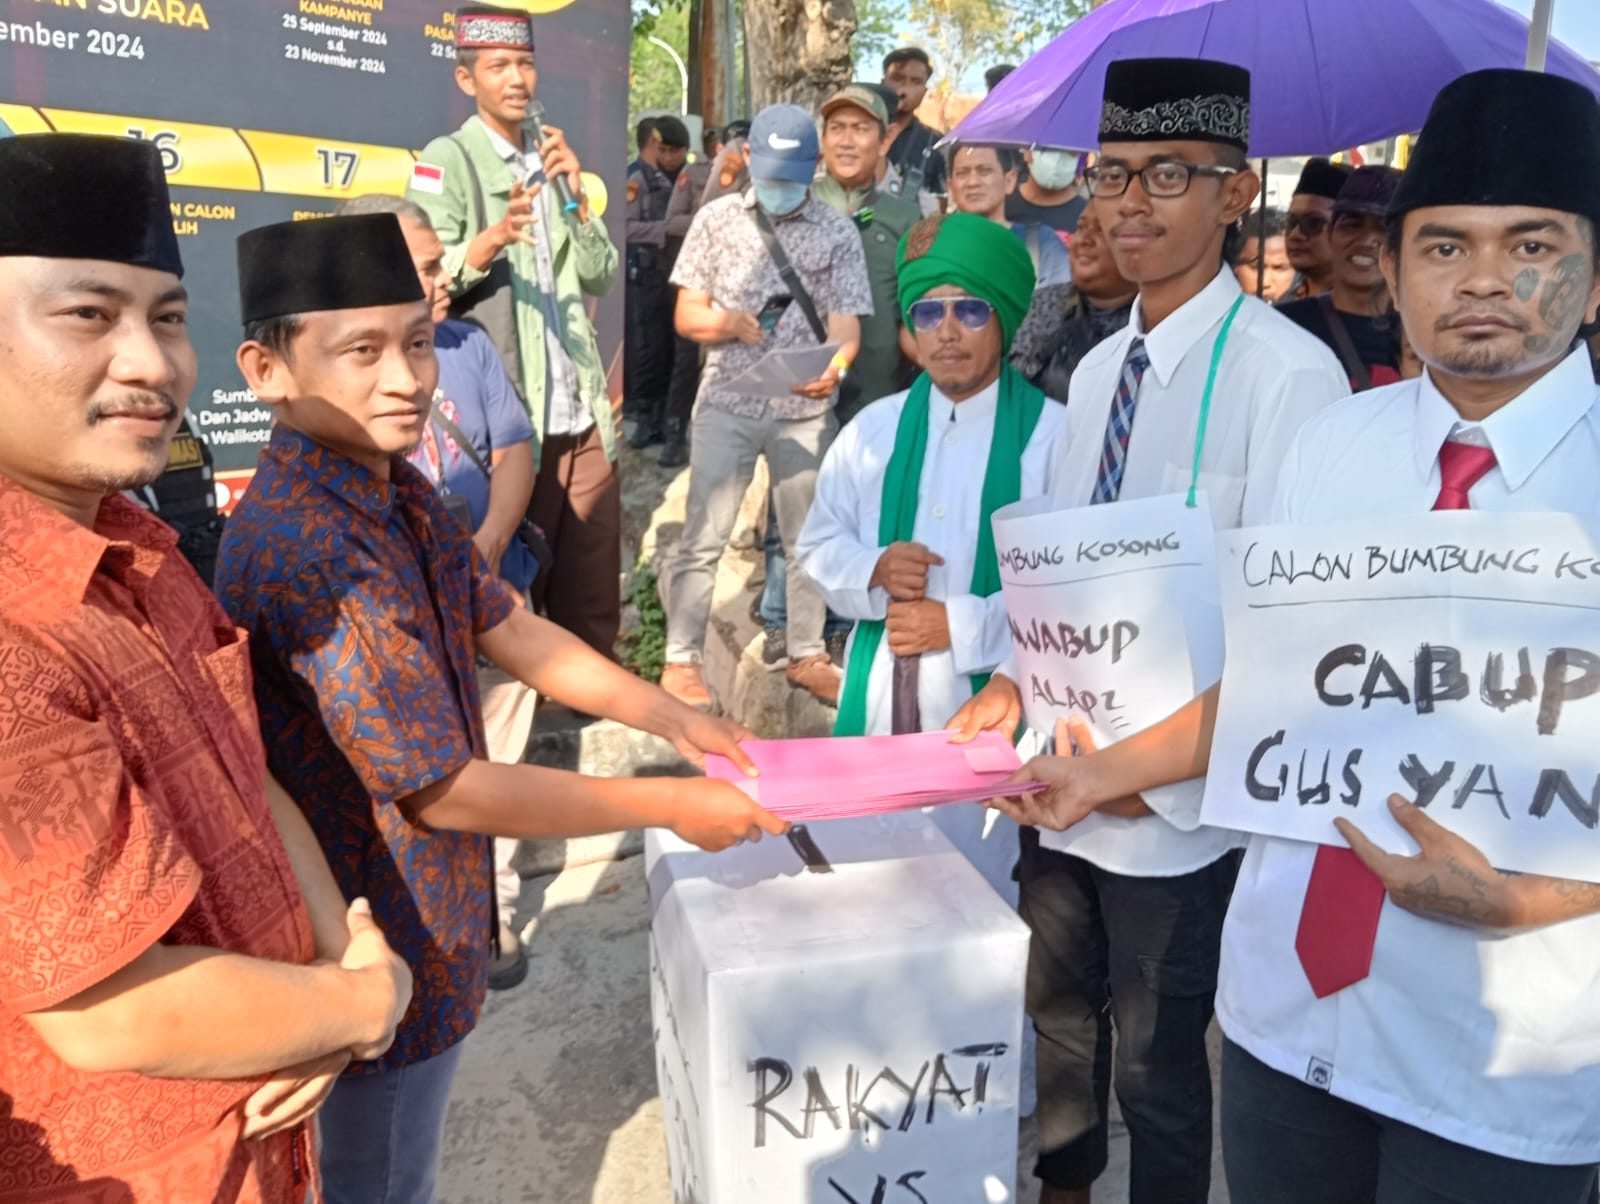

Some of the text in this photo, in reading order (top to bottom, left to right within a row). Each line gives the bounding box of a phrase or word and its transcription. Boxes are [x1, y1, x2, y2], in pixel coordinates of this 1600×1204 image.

[97, 0, 210, 30] SUARA
[299, 1, 372, 26] KAMPANYE
[86, 29, 145, 60] 2024
[282, 14, 388, 46] 25 September 2024
[284, 44, 386, 74] 23 November 2024
[127, 129, 180, 173] 6
[316, 148, 358, 187] 17
[183, 203, 236, 220] CALON
[199, 410, 232, 426] Dan
[1076, 531, 1181, 563] KOSONG
[1243, 541, 1352, 587] CALON
[1365, 545, 1540, 580] BUMBUNG
[1314, 641, 1600, 736] CABUP
[1244, 729, 1363, 808] GUS
[1398, 752, 1600, 829] YAN
[746, 1042, 1009, 1148] RAKYAT
